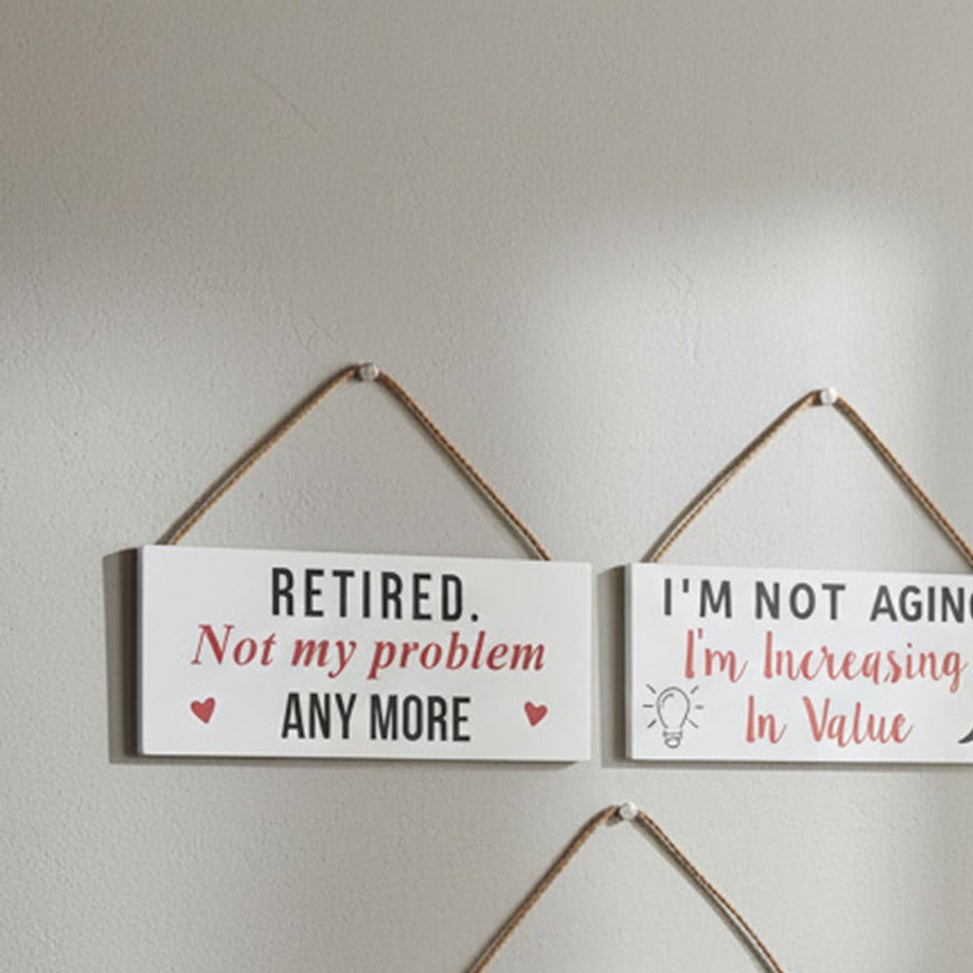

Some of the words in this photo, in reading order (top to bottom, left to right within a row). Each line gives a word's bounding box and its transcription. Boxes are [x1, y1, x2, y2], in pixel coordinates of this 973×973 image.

[272, 568, 478, 622] RETIRED.
[664, 578, 732, 618] I'M
[755, 581, 845, 620] NOT
[192, 625, 277, 666] Not
[291, 640, 356, 678] my
[367, 630, 546, 680] problem
[685, 628, 747, 683] I'm
[764, 631, 967, 693] Increasing
[282, 693, 357, 739] ANY
[370, 694, 471, 742] MORE
[746, 695, 786, 744] In
[803, 696, 912, 748] Value
